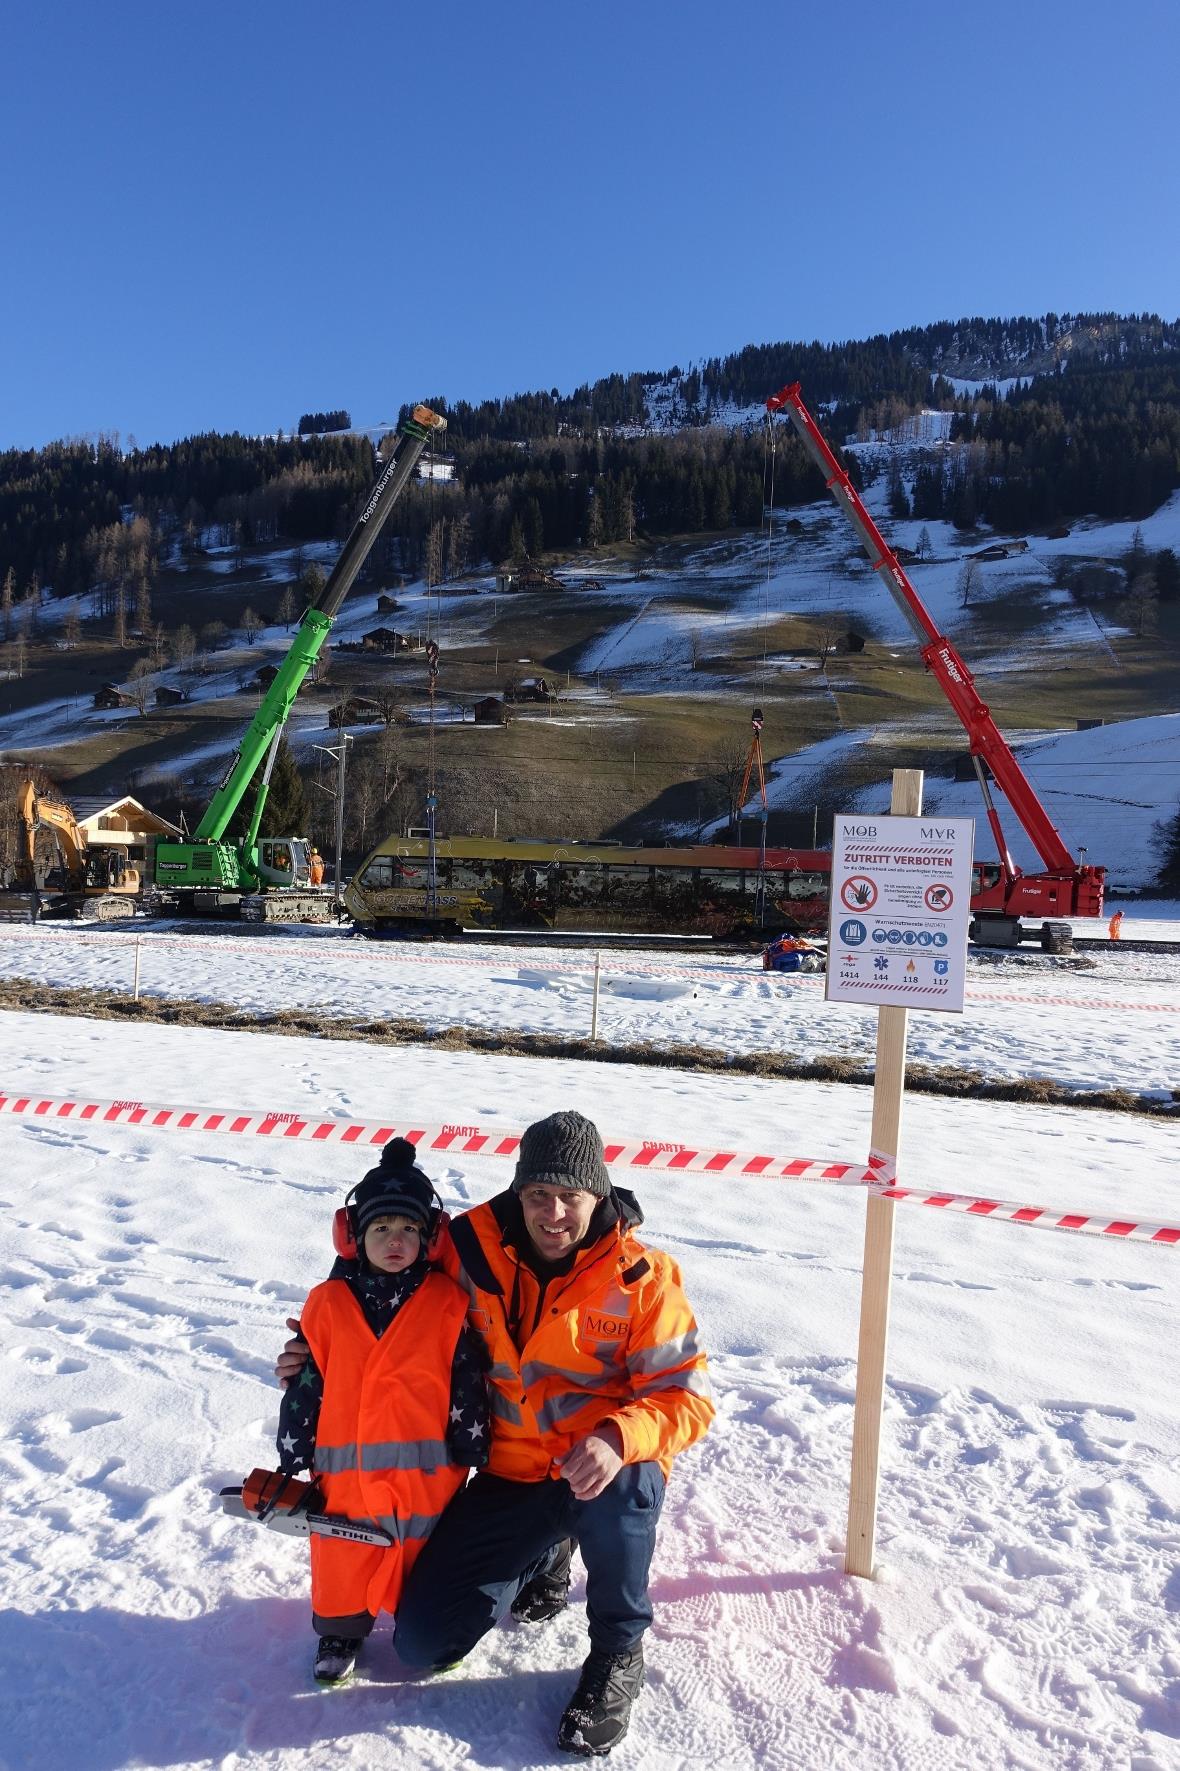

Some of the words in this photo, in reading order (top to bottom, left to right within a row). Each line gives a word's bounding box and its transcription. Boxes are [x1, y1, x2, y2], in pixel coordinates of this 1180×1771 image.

[360, 458, 397, 523] Toggenburger
[939, 648, 962, 683] Frutiger
[843, 825, 878, 837] MOB
[920, 828, 956, 840] MVR
[844, 853, 891, 864] ZUTRITT
[893, 855, 953, 867] VERBOTEN
[933, 978, 948, 986] 117
[112, 1100, 143, 1111] CHARTE
[266, 1112, 301, 1123] CHARTE
[441, 1125, 480, 1137] CHARTE
[642, 1141, 686, 1153] CHARTE
[586, 1316, 629, 1335] MOB
[331, 1528, 374, 1542] STIHL
